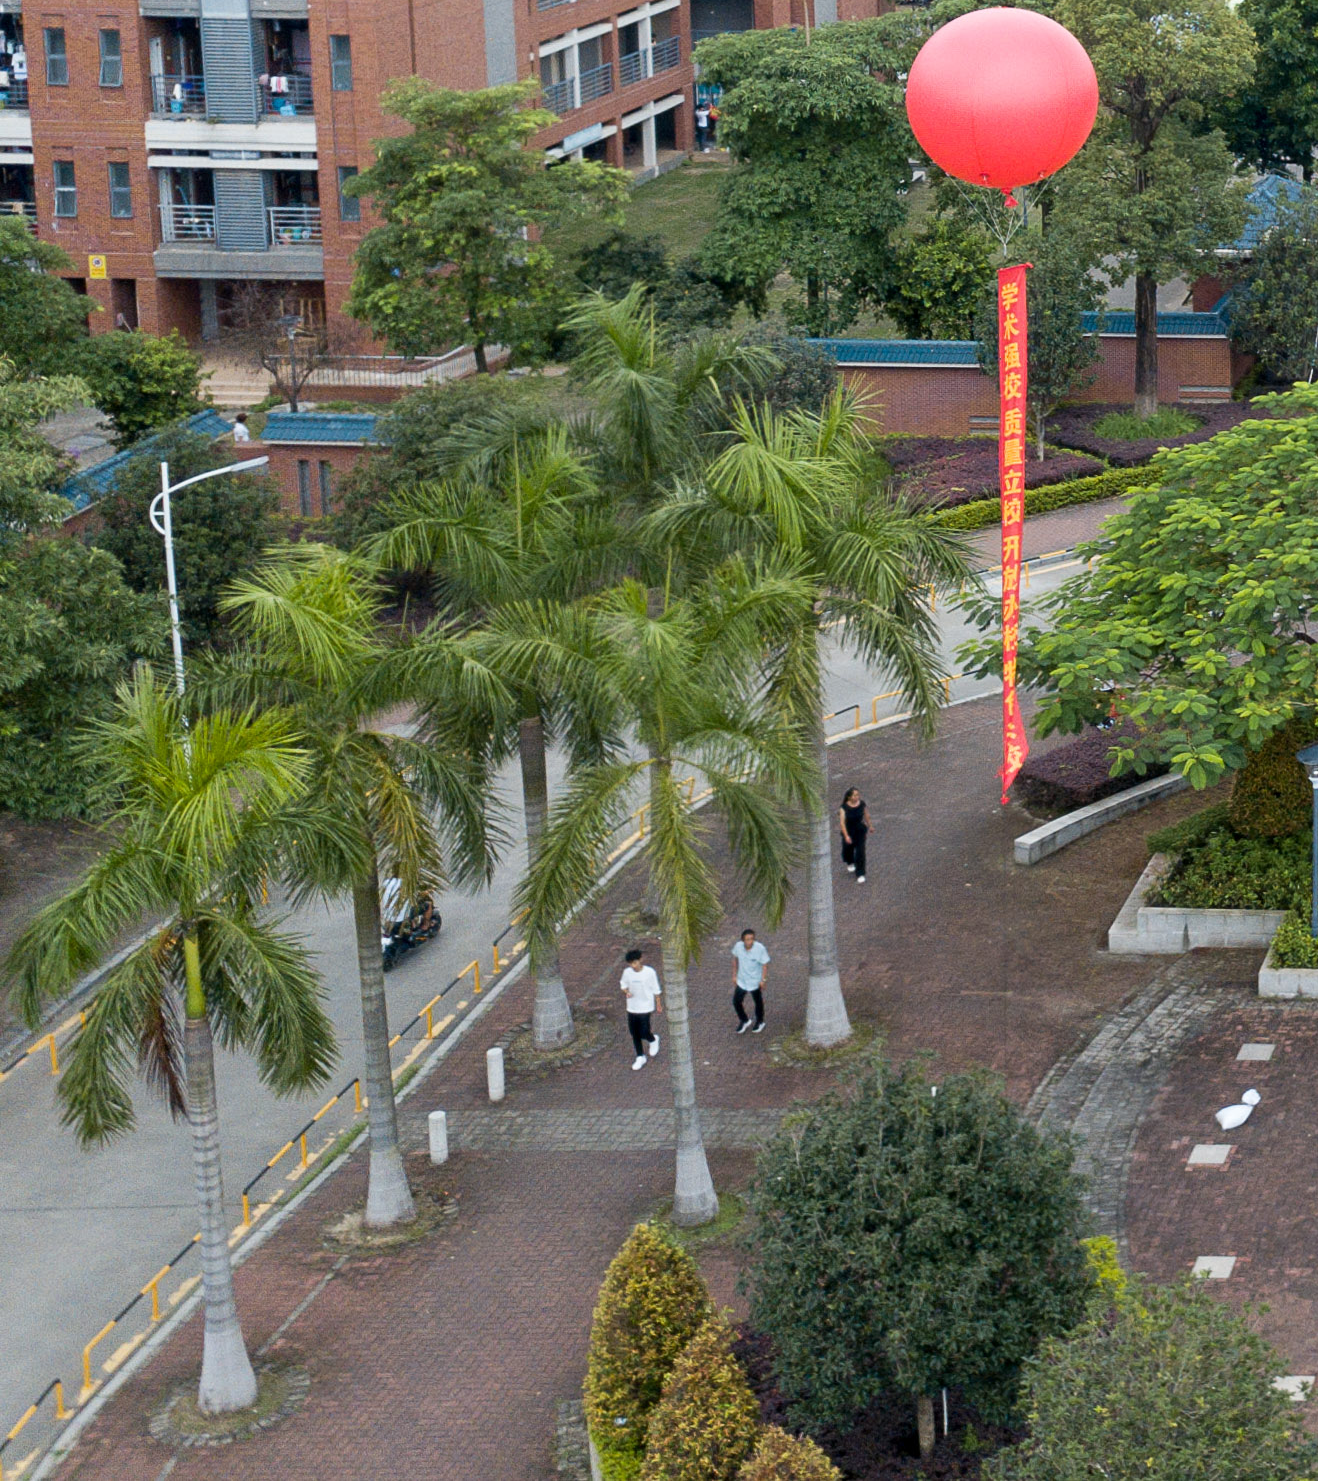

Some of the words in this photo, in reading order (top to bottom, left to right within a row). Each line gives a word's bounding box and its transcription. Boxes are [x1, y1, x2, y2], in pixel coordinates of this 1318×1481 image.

[1002, 283, 1022, 398] 学术强校
[1003, 408, 1022, 526] 质量立校
